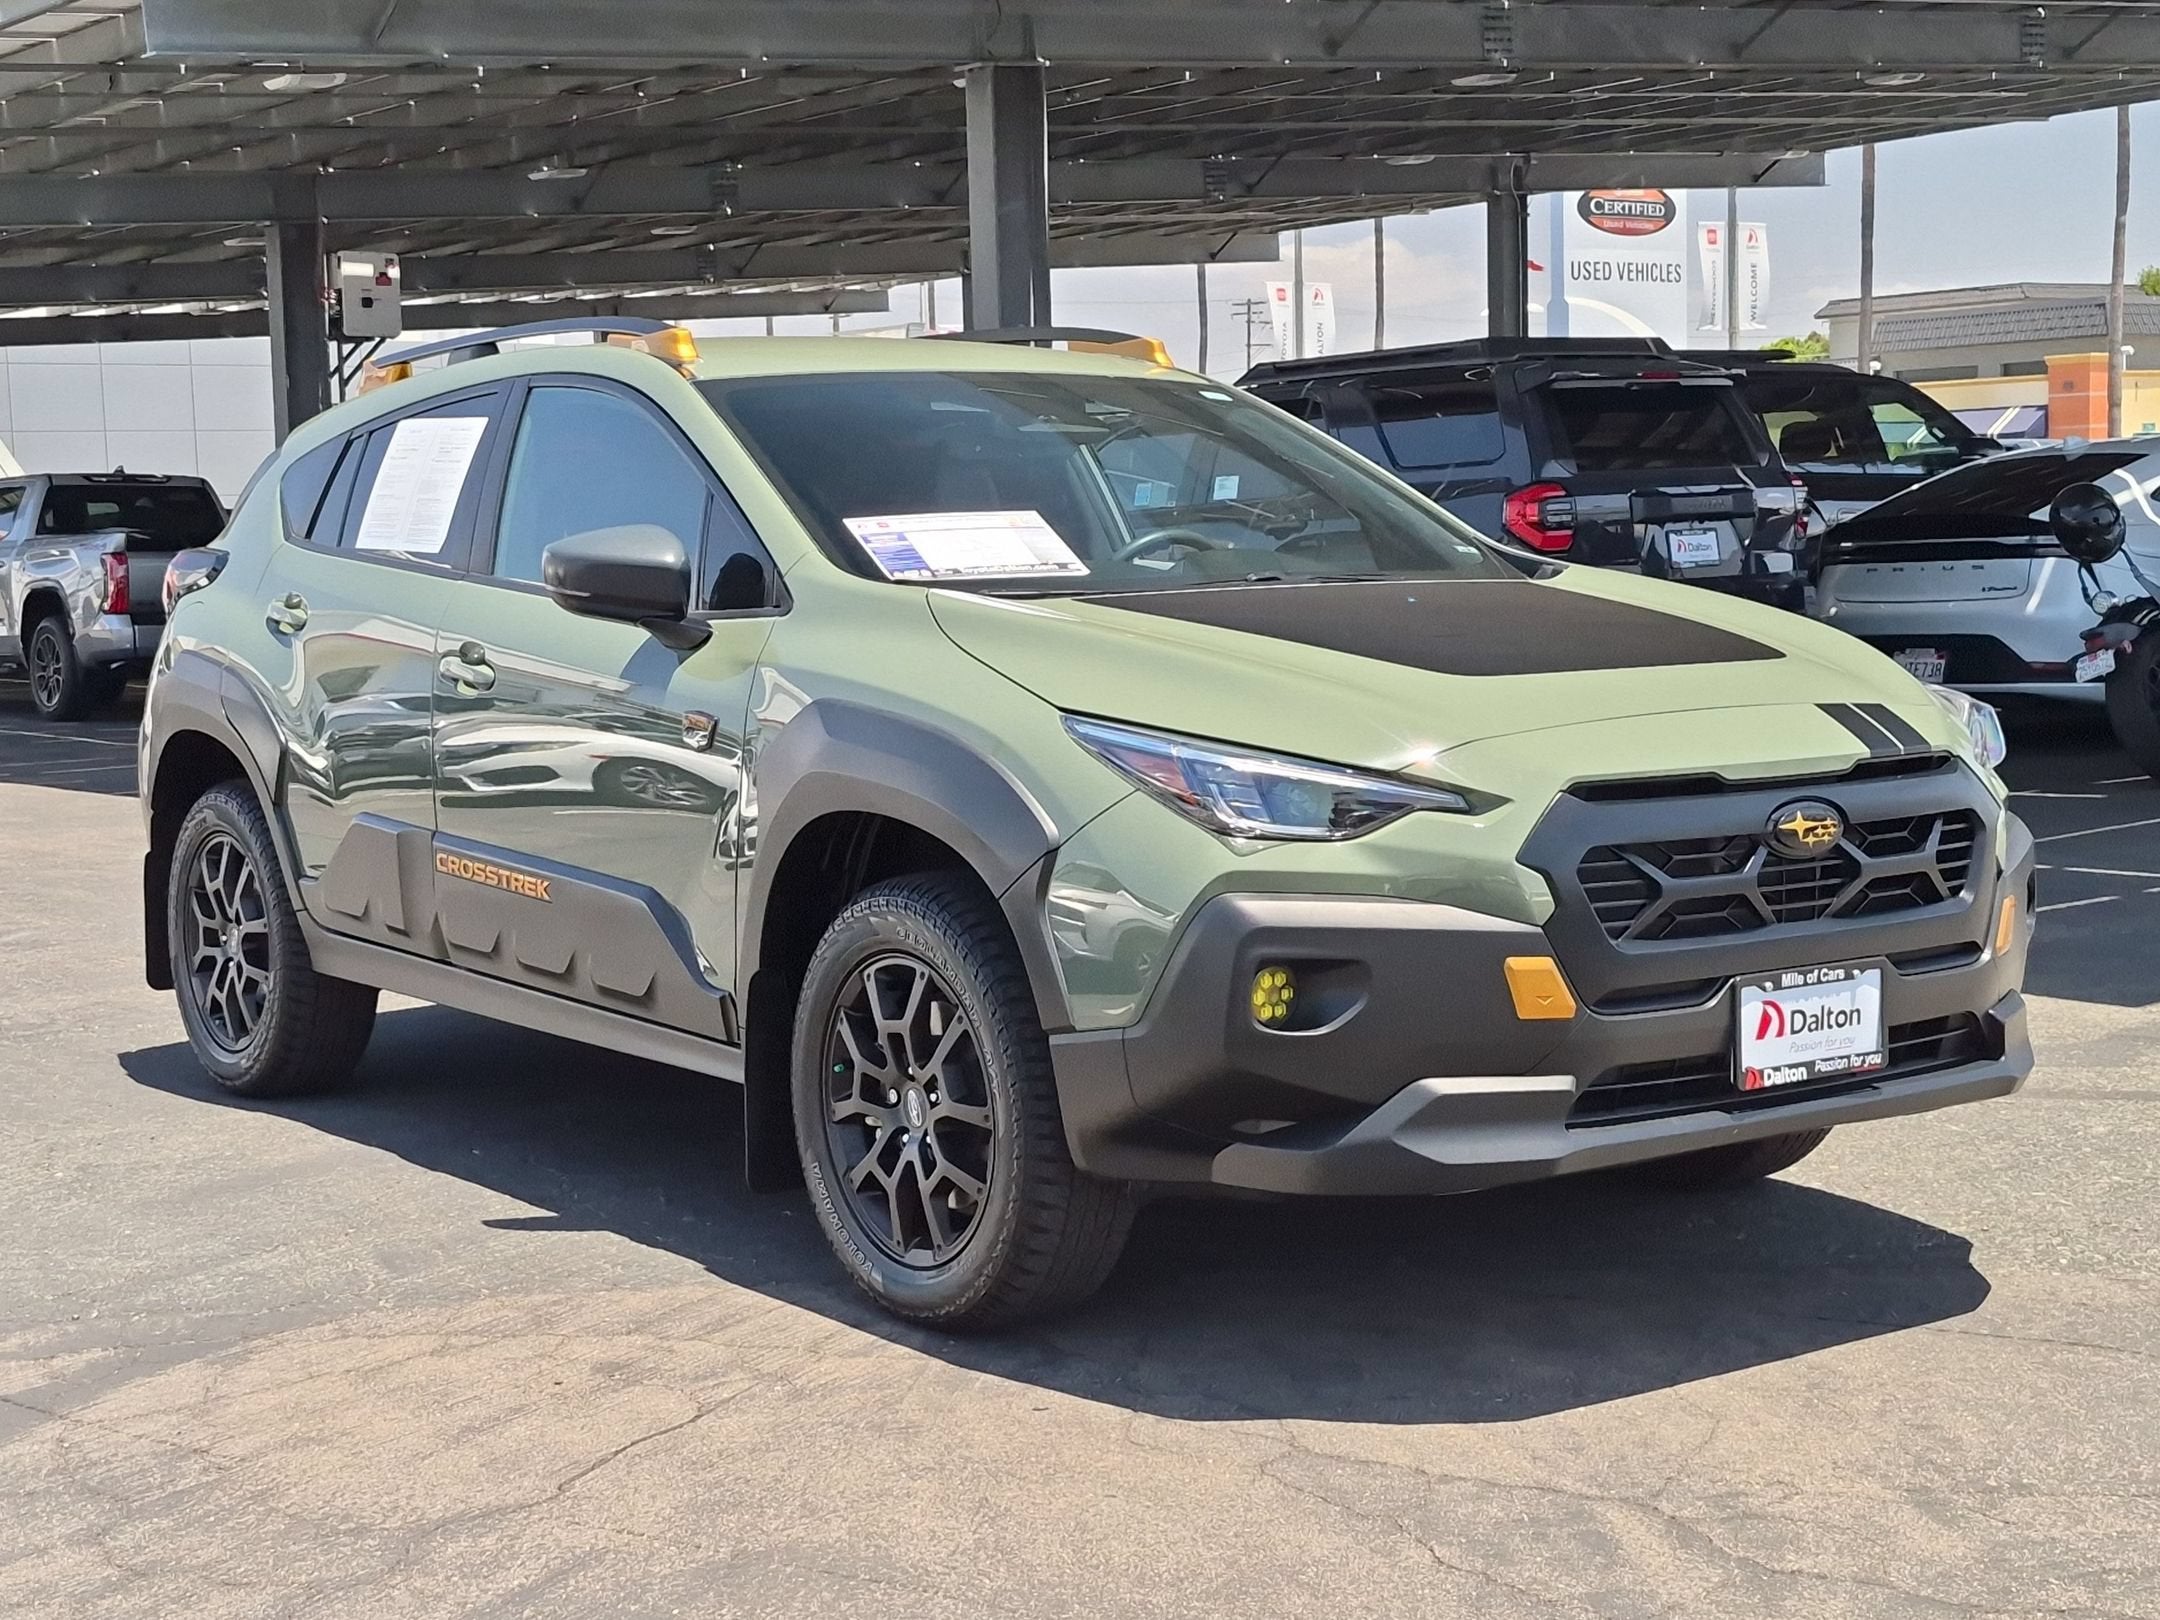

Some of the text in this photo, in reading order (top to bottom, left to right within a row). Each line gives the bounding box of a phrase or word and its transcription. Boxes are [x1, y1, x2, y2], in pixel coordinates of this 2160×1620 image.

[1590, 198, 1665, 217] CERTIFIED
[1571, 260, 1682, 283] USED VEHICLES
[1750, 262, 1758, 322] WELCOME
[436, 852, 552, 903] CROSSTREK
[1781, 968, 1845, 988] Mile of Cars
[1790, 1005, 1861, 1035] Dalton
[1789, 1036, 1856, 1053] Passion for you
[1814, 1053, 1882, 1073] Passion for you
[1763, 1065, 1808, 1086] Dalton
[811, 1162, 874, 1276] YOKOHAMA
